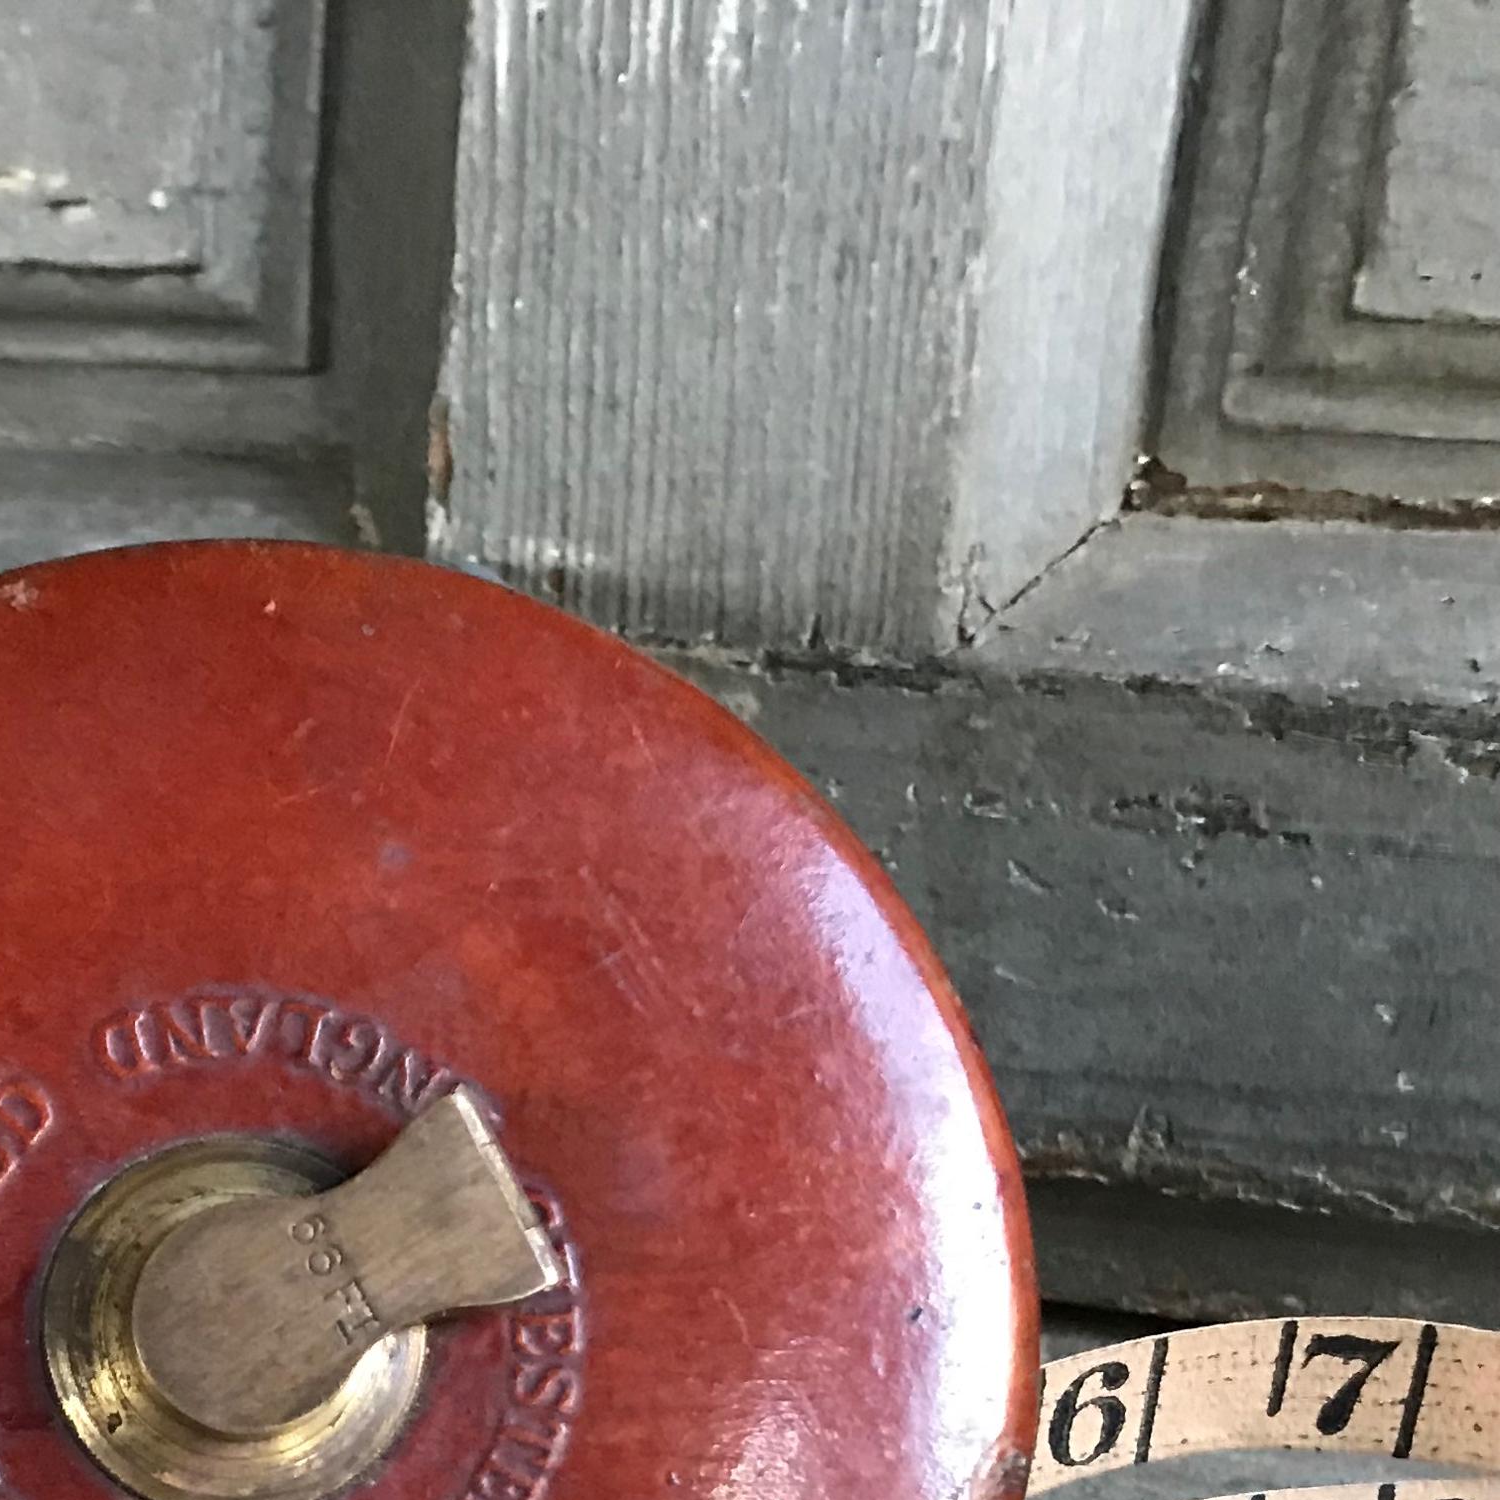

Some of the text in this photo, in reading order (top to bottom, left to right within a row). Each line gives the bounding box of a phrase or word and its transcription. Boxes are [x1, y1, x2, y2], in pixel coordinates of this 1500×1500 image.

[100, 998, 470, 1112] NGLAND
[1047, 1333, 1403, 1467] 6 7
